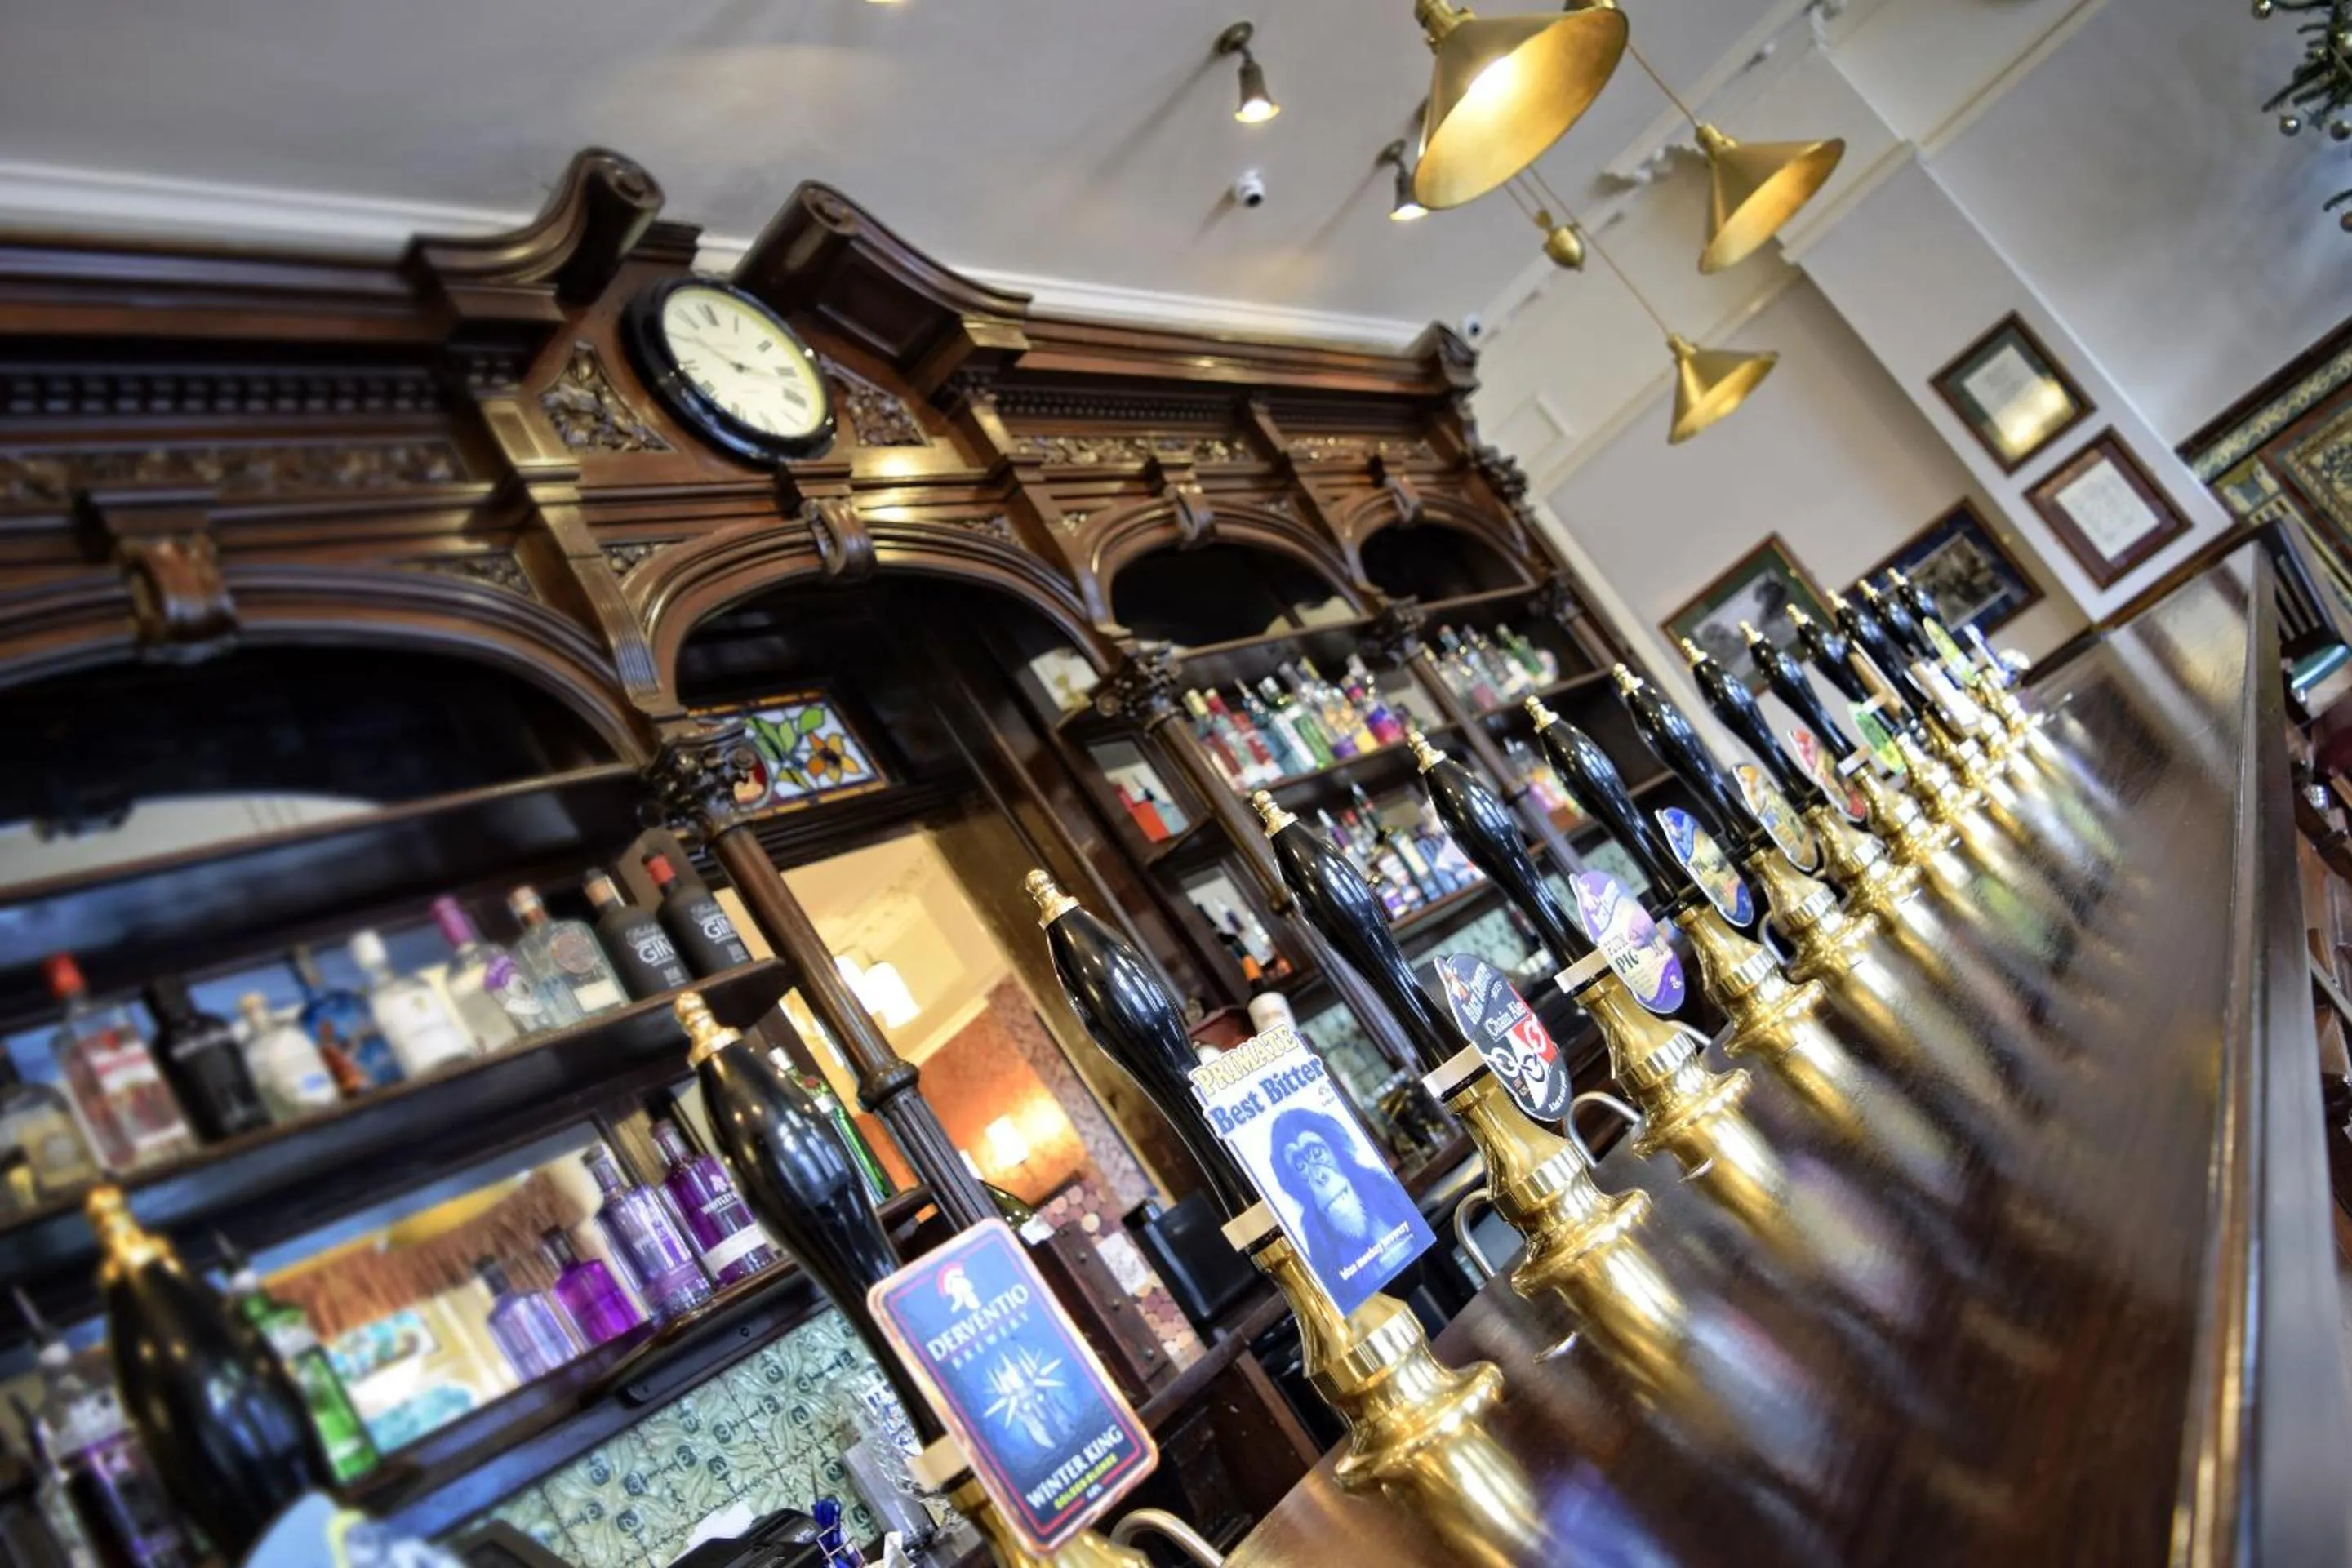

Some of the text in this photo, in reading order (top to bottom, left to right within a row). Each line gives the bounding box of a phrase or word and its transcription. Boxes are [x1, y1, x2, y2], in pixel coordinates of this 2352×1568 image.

[639, 939, 674, 964] GIN
[1193, 1025, 1299, 1096] PRIMATE
[1208, 1059, 1323, 1135] Best Bitter
[926, 1283, 1029, 1362] DERVENTIO
[1025, 1454, 1089, 1508] WINTER
[1082, 1423, 1125, 1464] KING
